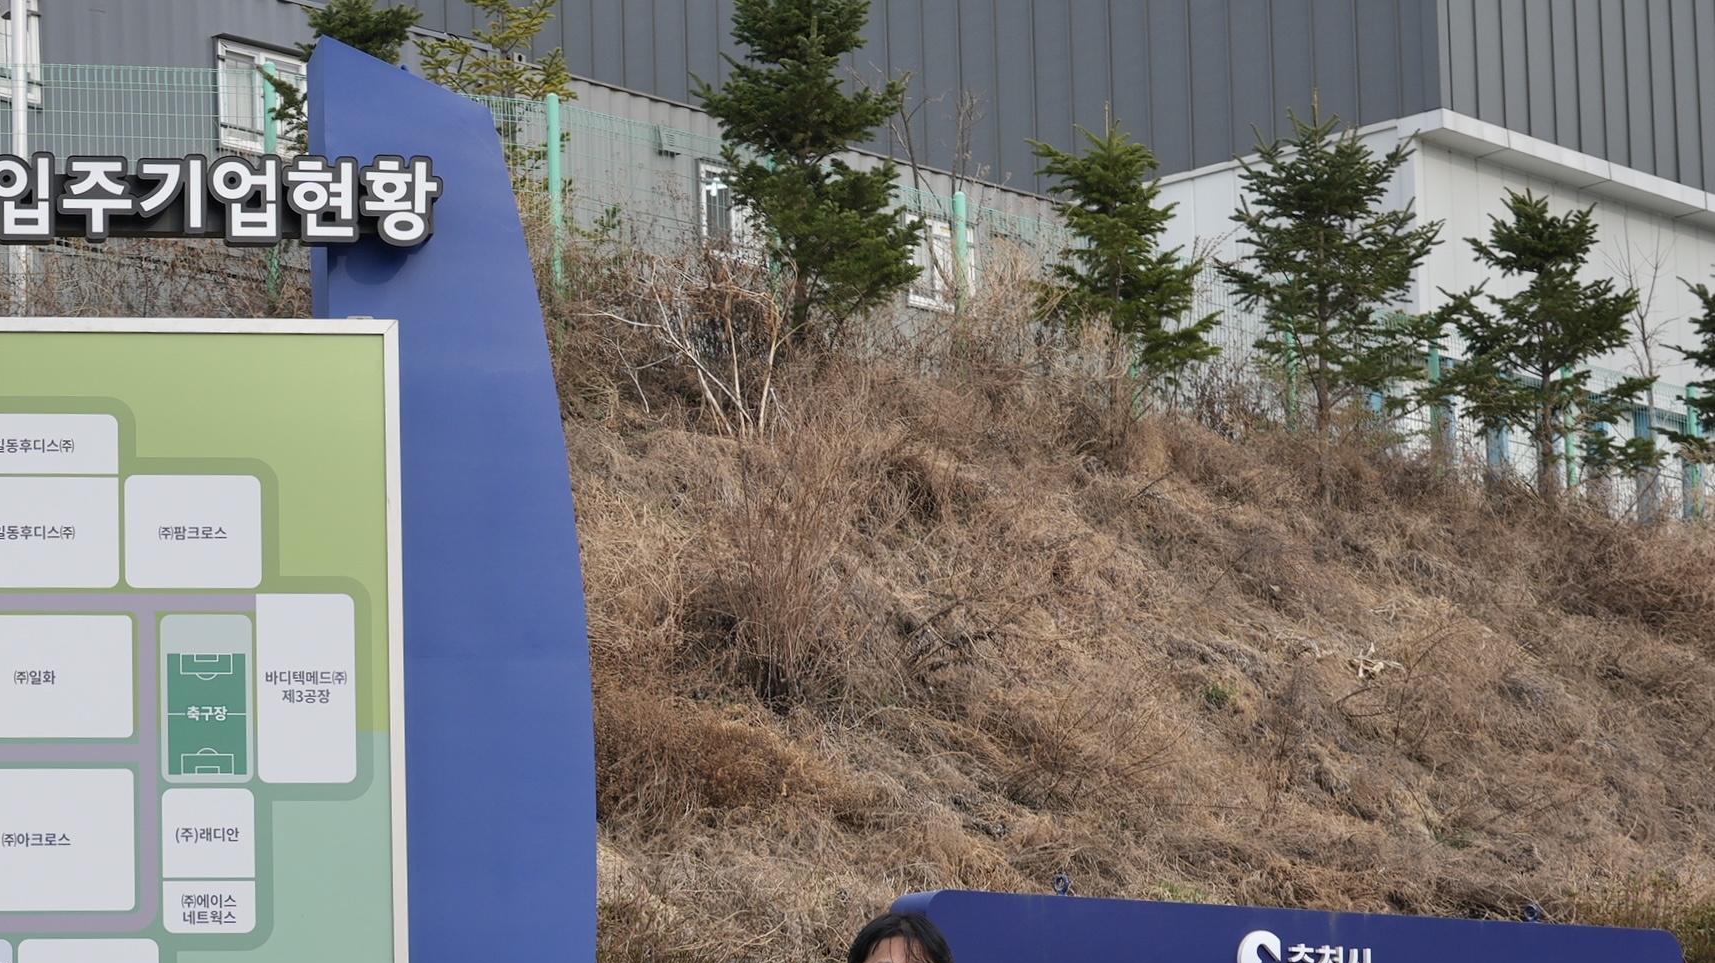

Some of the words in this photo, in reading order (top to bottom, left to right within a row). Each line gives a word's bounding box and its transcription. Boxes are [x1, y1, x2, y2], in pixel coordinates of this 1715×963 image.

[281, 688, 331, 704] 제3공장
[186, 705, 228, 722] 축구장
[175, 826, 240, 844] (주)래디안
[182, 910, 237, 926] 네트웍스
